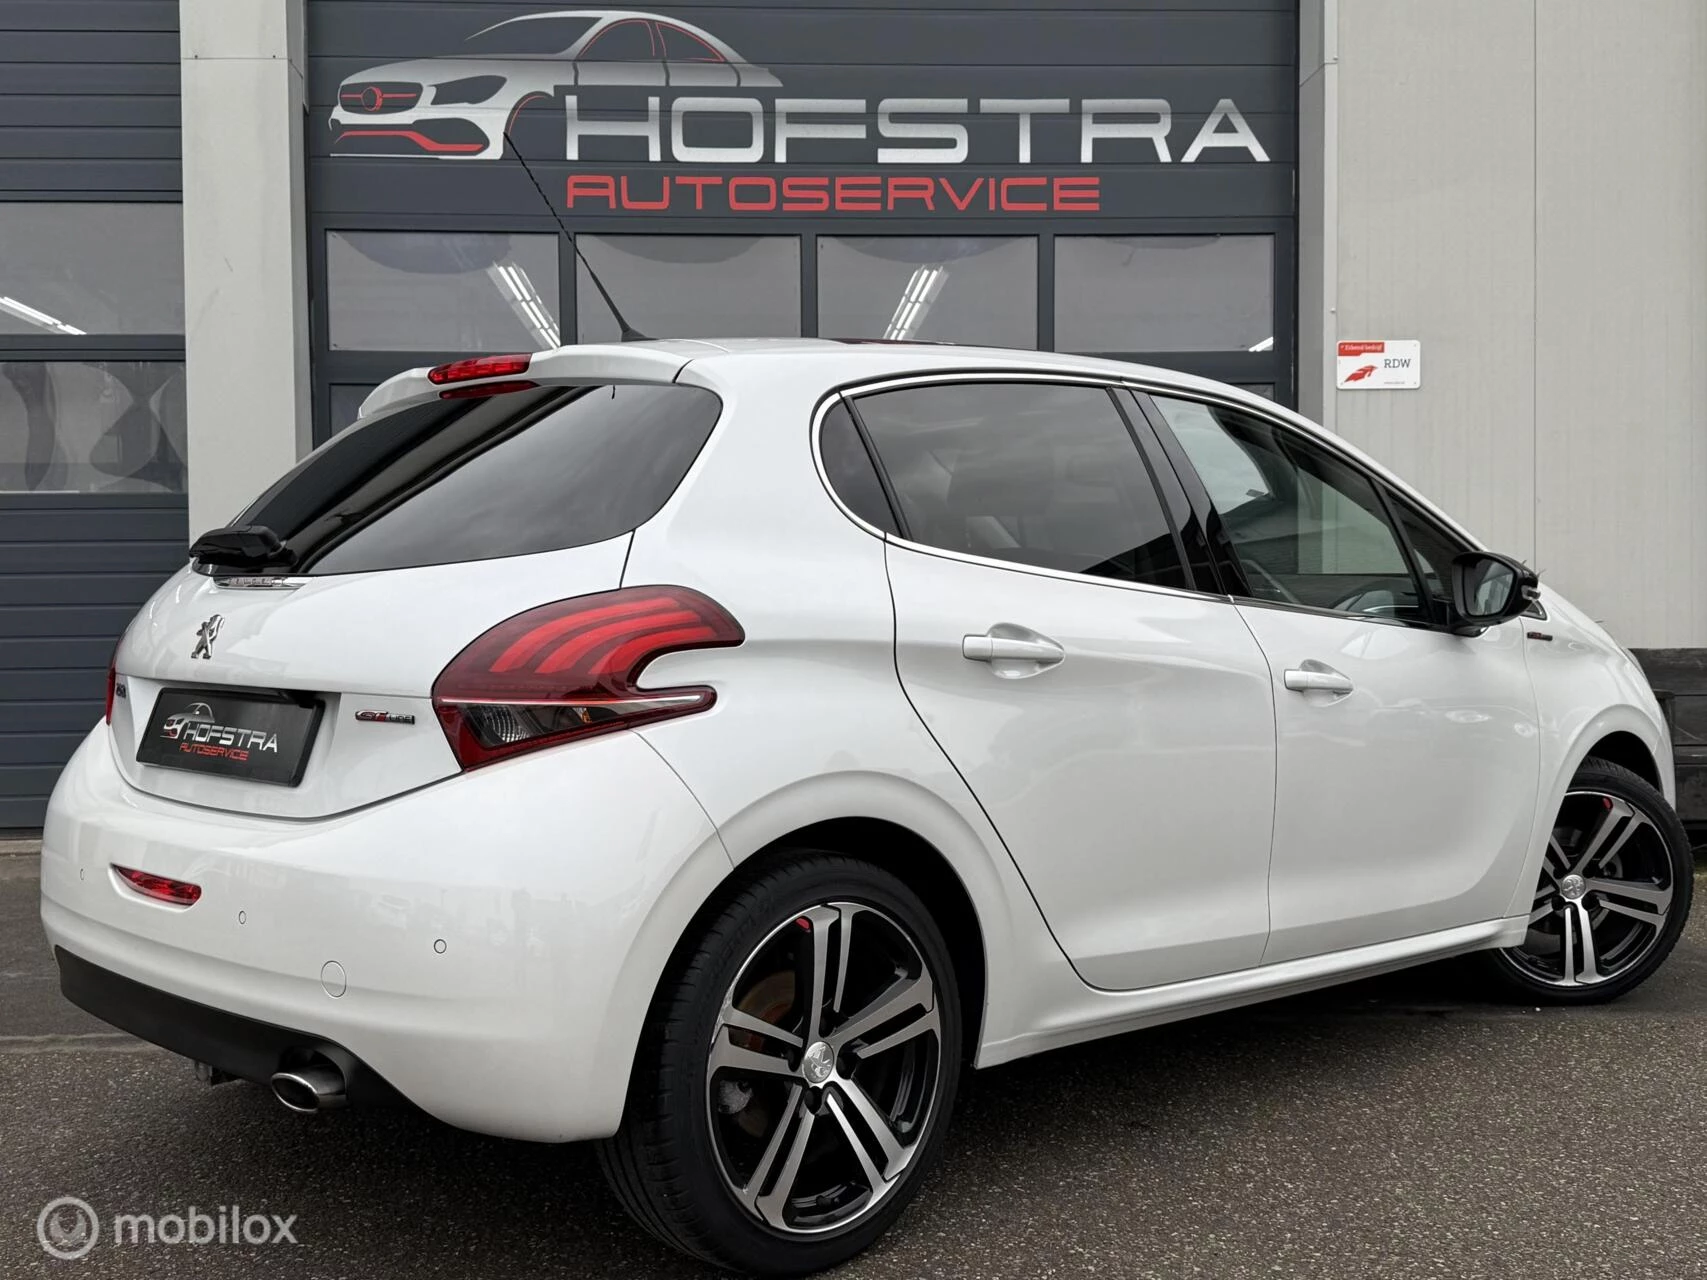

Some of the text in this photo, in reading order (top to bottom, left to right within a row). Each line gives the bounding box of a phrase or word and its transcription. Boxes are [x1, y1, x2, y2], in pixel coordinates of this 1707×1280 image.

[566, 95, 1270, 164] HOFSTRA
[566, 175, 1100, 211] AUTOSERVICE
[1384, 358, 1411, 369] RDW
[180, 742, 249, 761] AUTOSERVICE
[183, 722, 278, 753] HOFSTRA
